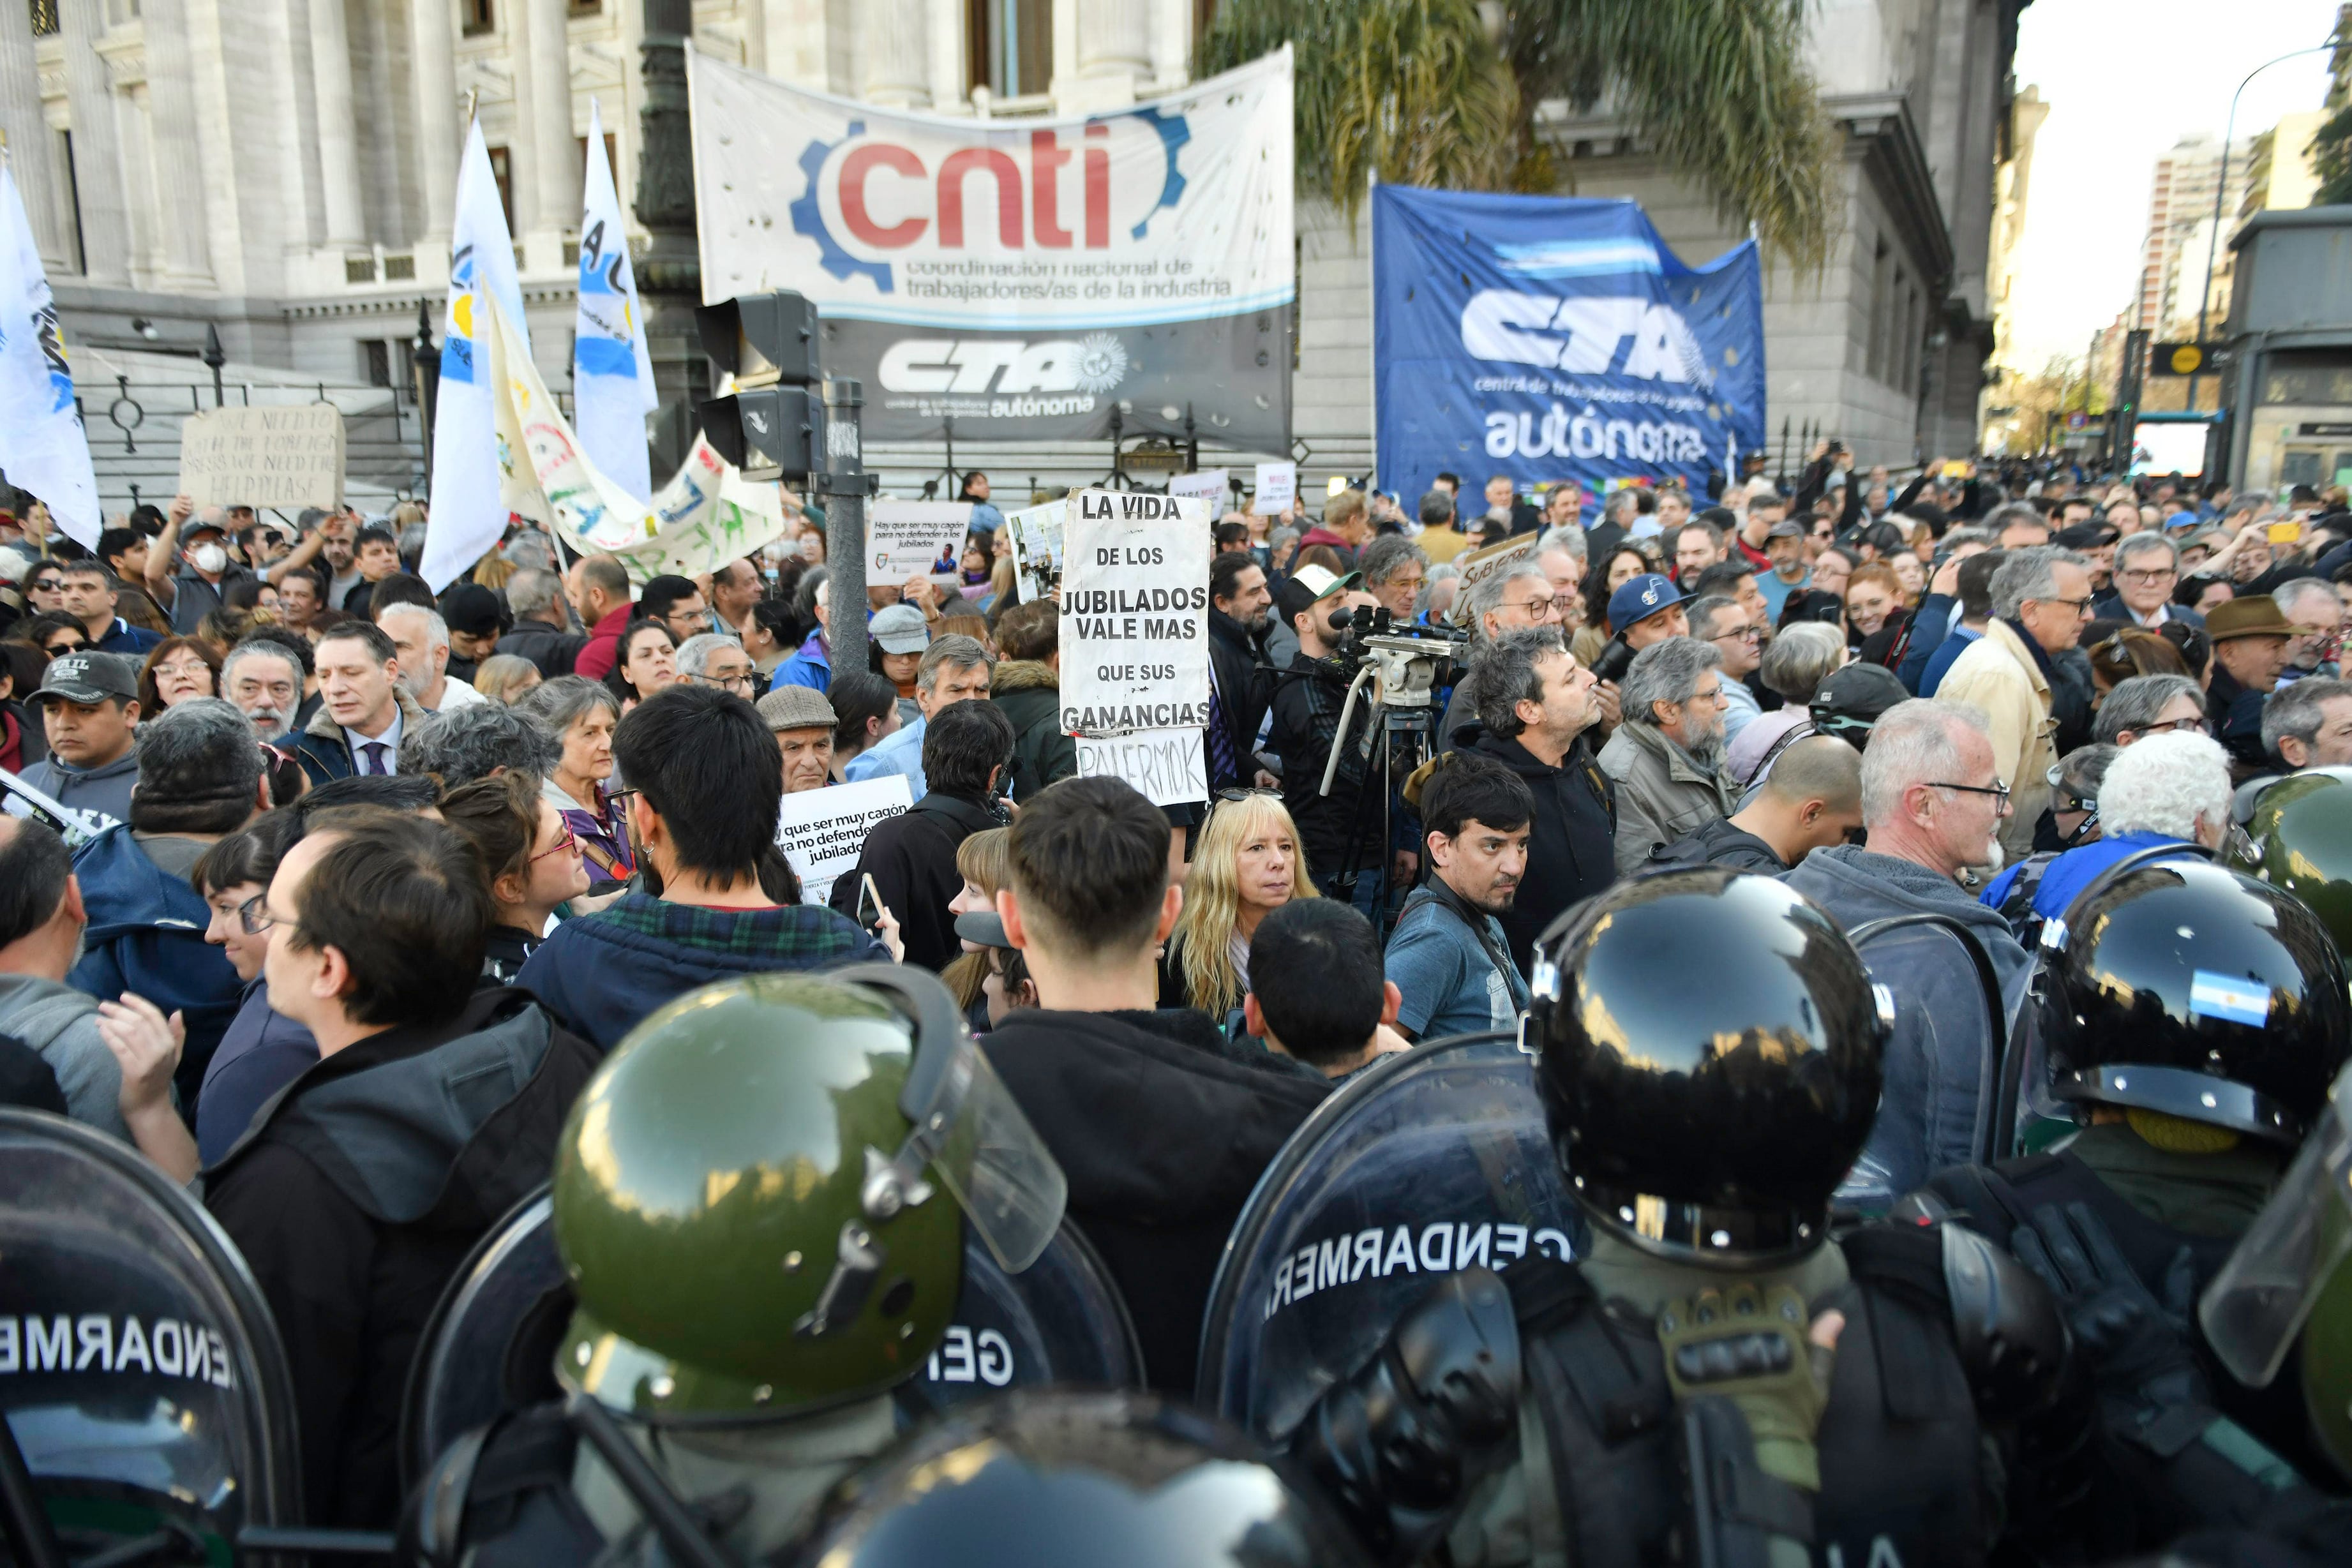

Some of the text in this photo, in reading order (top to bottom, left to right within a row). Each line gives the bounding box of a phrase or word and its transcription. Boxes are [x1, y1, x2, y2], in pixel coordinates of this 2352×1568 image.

[838, 124, 1111, 250] cnti
[1063, 259, 1157, 277] nacional
[1165, 257, 1192, 274] de
[906, 276, 1232, 302] trabajadores/as de la industria
[1461, 288, 1693, 384] CTA
[878, 339, 1080, 393] CTA
[990, 394, 1095, 417] autónoma
[1082, 496, 1114, 520] LA
[1122, 496, 1182, 521] VIDA
[874, 521, 892, 531] Hay
[892, 523, 908, 532] que
[922, 523, 940, 531] muy
[941, 521, 964, 531] cagón
[875, 532, 894, 541] para
[907, 530, 942, 539] defender
[949, 530, 960, 539] los
[897, 541, 934, 550] jubilados
[1097, 547, 1164, 566] DE LOS
[1061, 586, 1206, 616] JUBILADOS
[1076, 618, 1197, 640] VALE MAS
[51, 659, 89, 671] VAIL
[1097, 664, 1176, 682] QUE SUS
[1062, 702, 1210, 731] GANANCIAS
[784, 822, 811, 839] que
[813, 818, 834, 831] ser
[835, 812, 865, 828] muy
[867, 803, 908, 821] cagón
[781, 841, 795, 854] ra
[797, 837, 814, 850] no
[809, 840, 862, 865] jubilado
